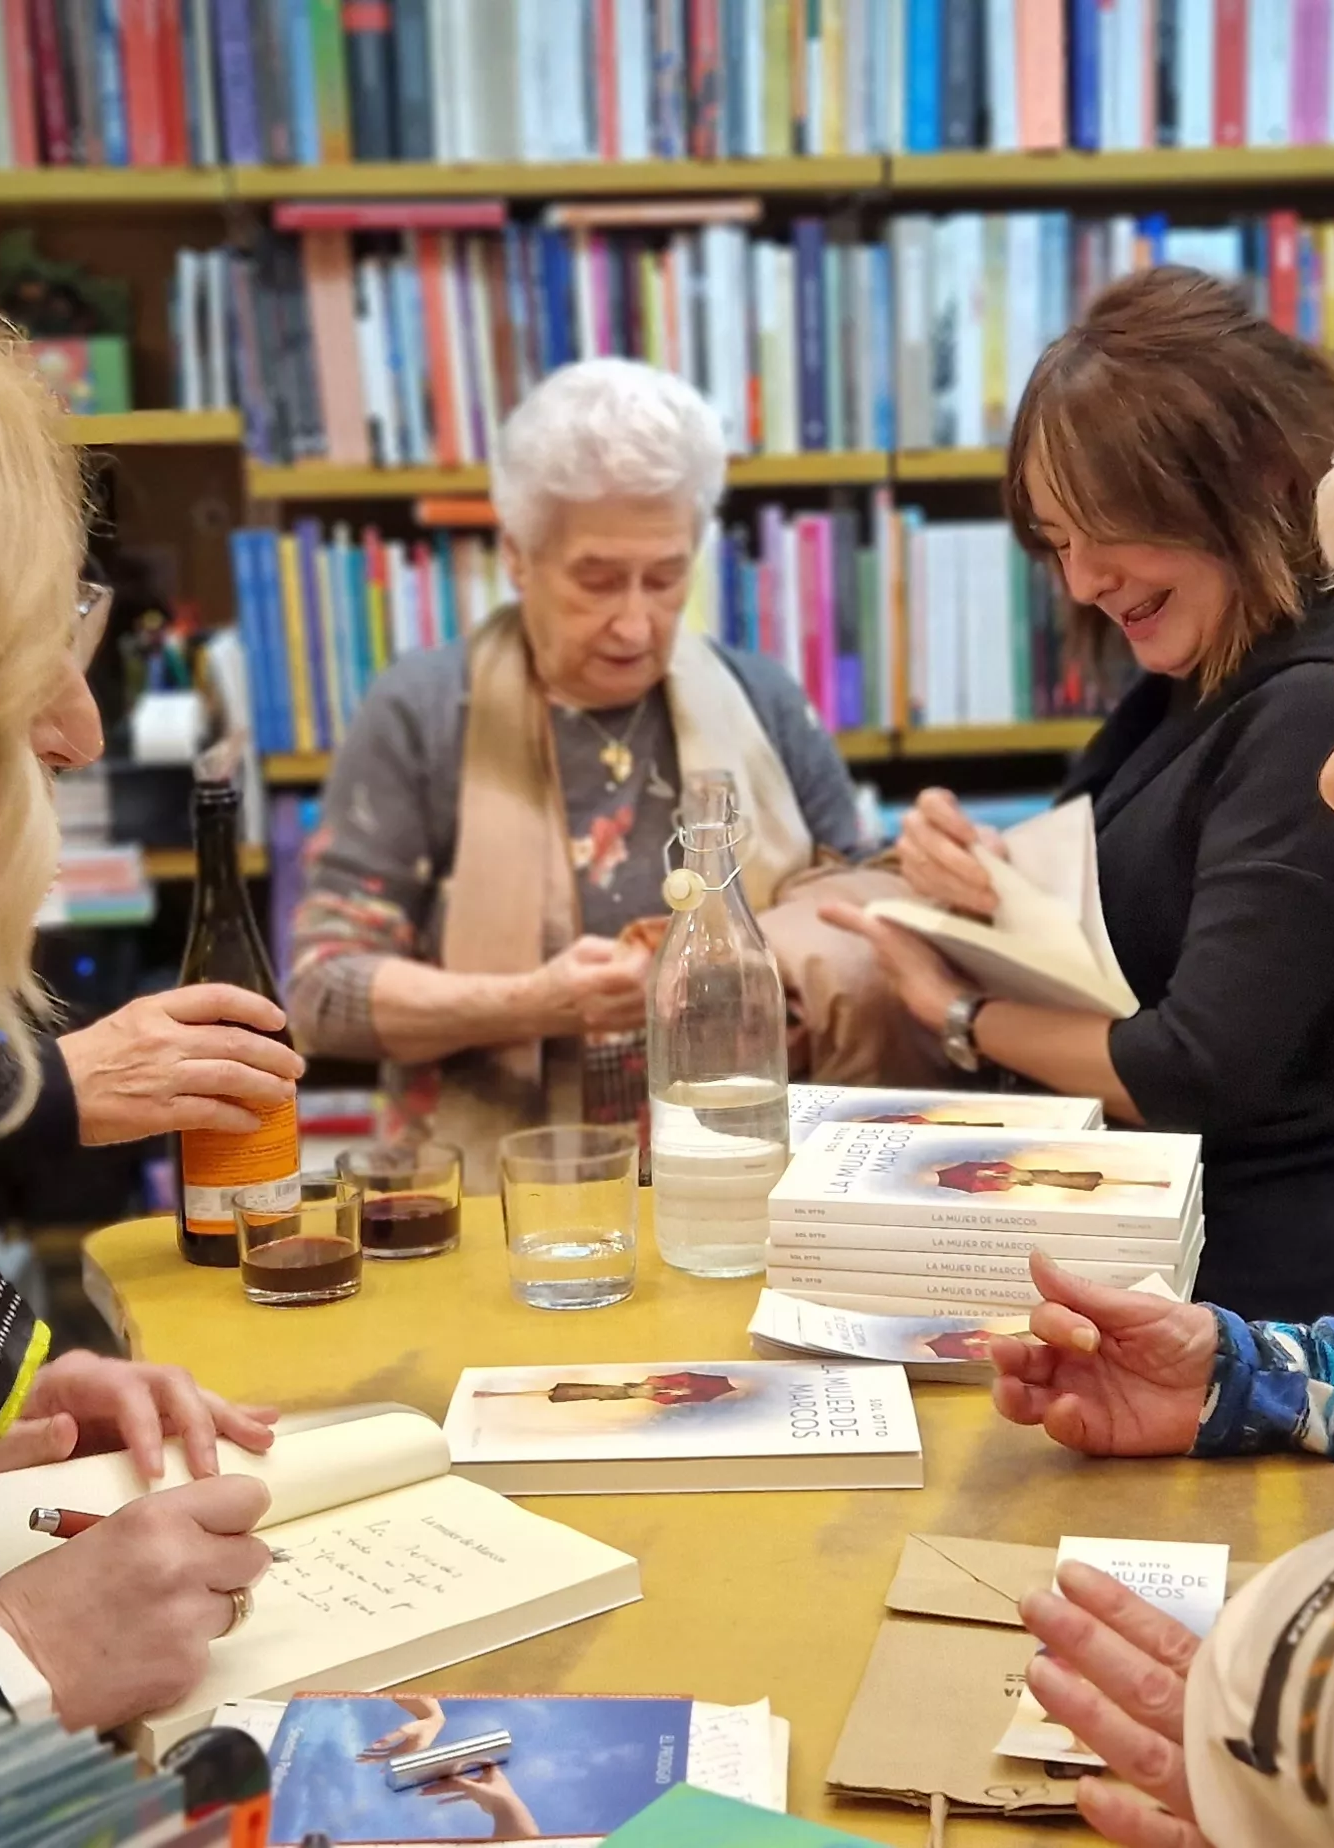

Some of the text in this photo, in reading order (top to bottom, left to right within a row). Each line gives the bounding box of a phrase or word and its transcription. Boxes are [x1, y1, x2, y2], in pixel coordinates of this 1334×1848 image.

[868, 1129, 914, 1174] MARCOS
[823, 1128, 884, 1194] LA MUJER DE
[946, 1214, 977, 1224] MUJER
[980, 1215, 992, 1224] DE
[995, 1217, 1038, 1226] MARCOS
[932, 1238, 944, 1246] LA
[947, 1239, 978, 1248] MUJER
[980, 1240, 993, 1249] DE
[926, 1262, 938, 1270] LA
[940, 1263, 972, 1271] MUJER
[974, 1265, 987, 1274] DE
[927, 1285, 1031, 1300] LA MUJER DE MARCOS
[822, 1377, 856, 1415] MUJER
[788, 1384, 821, 1439] MARCOS
[869, 1398, 889, 1438] SOL OTTO
[828, 1418, 860, 1438] DE
[1111, 1560, 1171, 1570] SOL OTTO
[1181, 1574, 1209, 1588] DE
